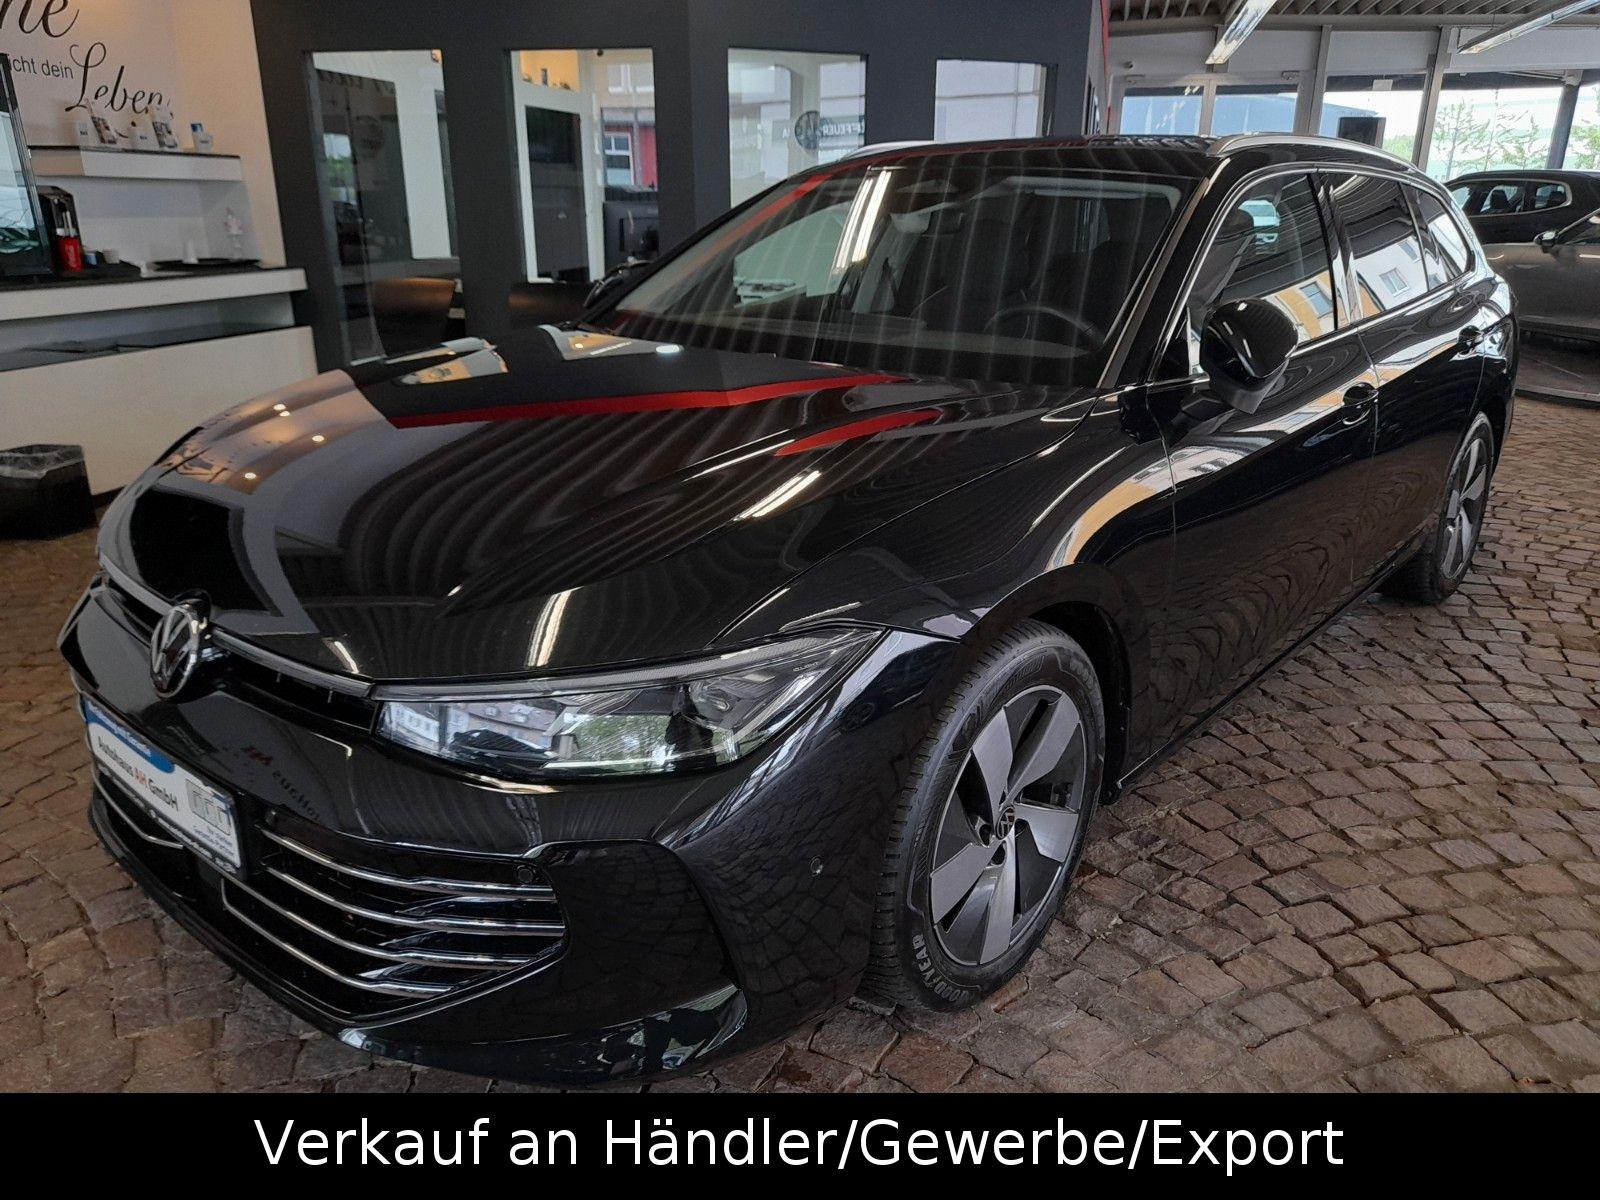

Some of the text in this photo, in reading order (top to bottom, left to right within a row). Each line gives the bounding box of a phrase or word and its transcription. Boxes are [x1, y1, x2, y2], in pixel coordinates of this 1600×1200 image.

[41, 59, 74, 79] dein
[65, 42, 163, 114] Leben
[148, 778, 178, 811] GmbH
